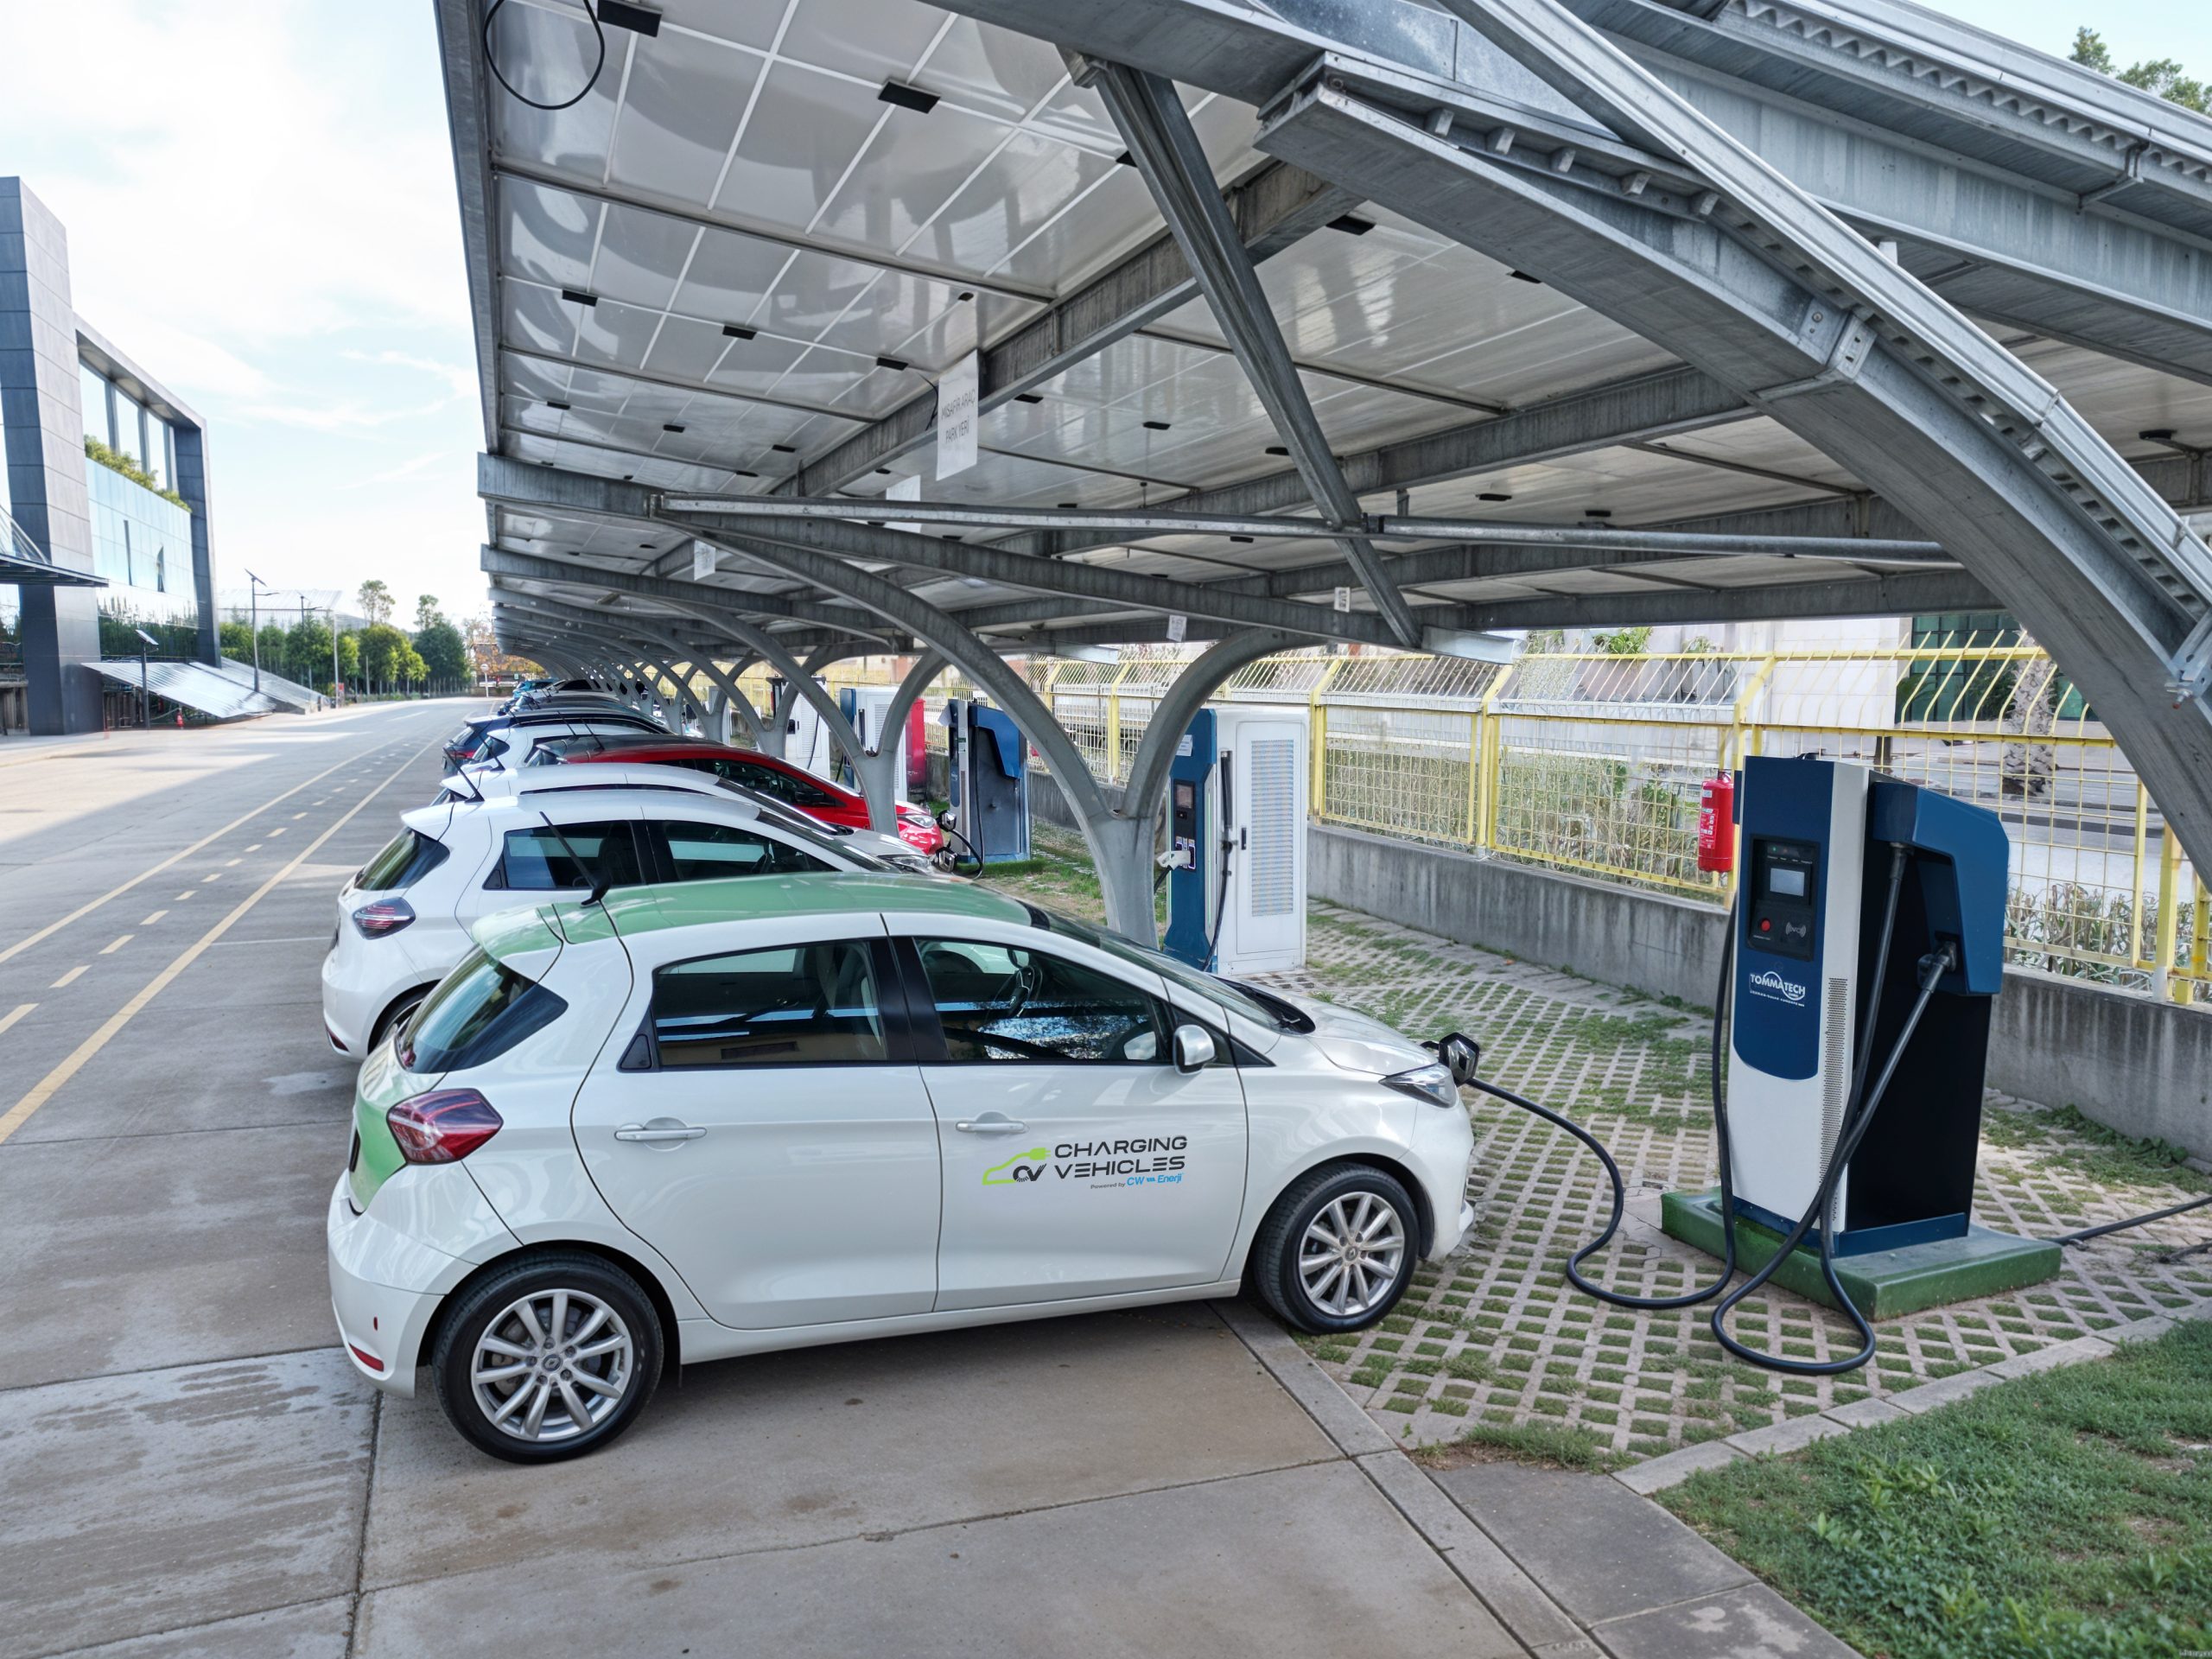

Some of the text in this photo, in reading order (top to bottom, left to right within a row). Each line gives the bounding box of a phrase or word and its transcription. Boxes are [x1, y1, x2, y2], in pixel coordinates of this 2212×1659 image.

[945, 424, 958, 444] PARK
[1750, 974, 1806, 995] TOMMATECH
[1054, 1135, 1188, 1158] CHARGING
[1054, 1155, 1185, 1179] VEHICLES
[1127, 1176, 1145, 1186] CW
[1158, 1173, 1183, 1184] Enerji
